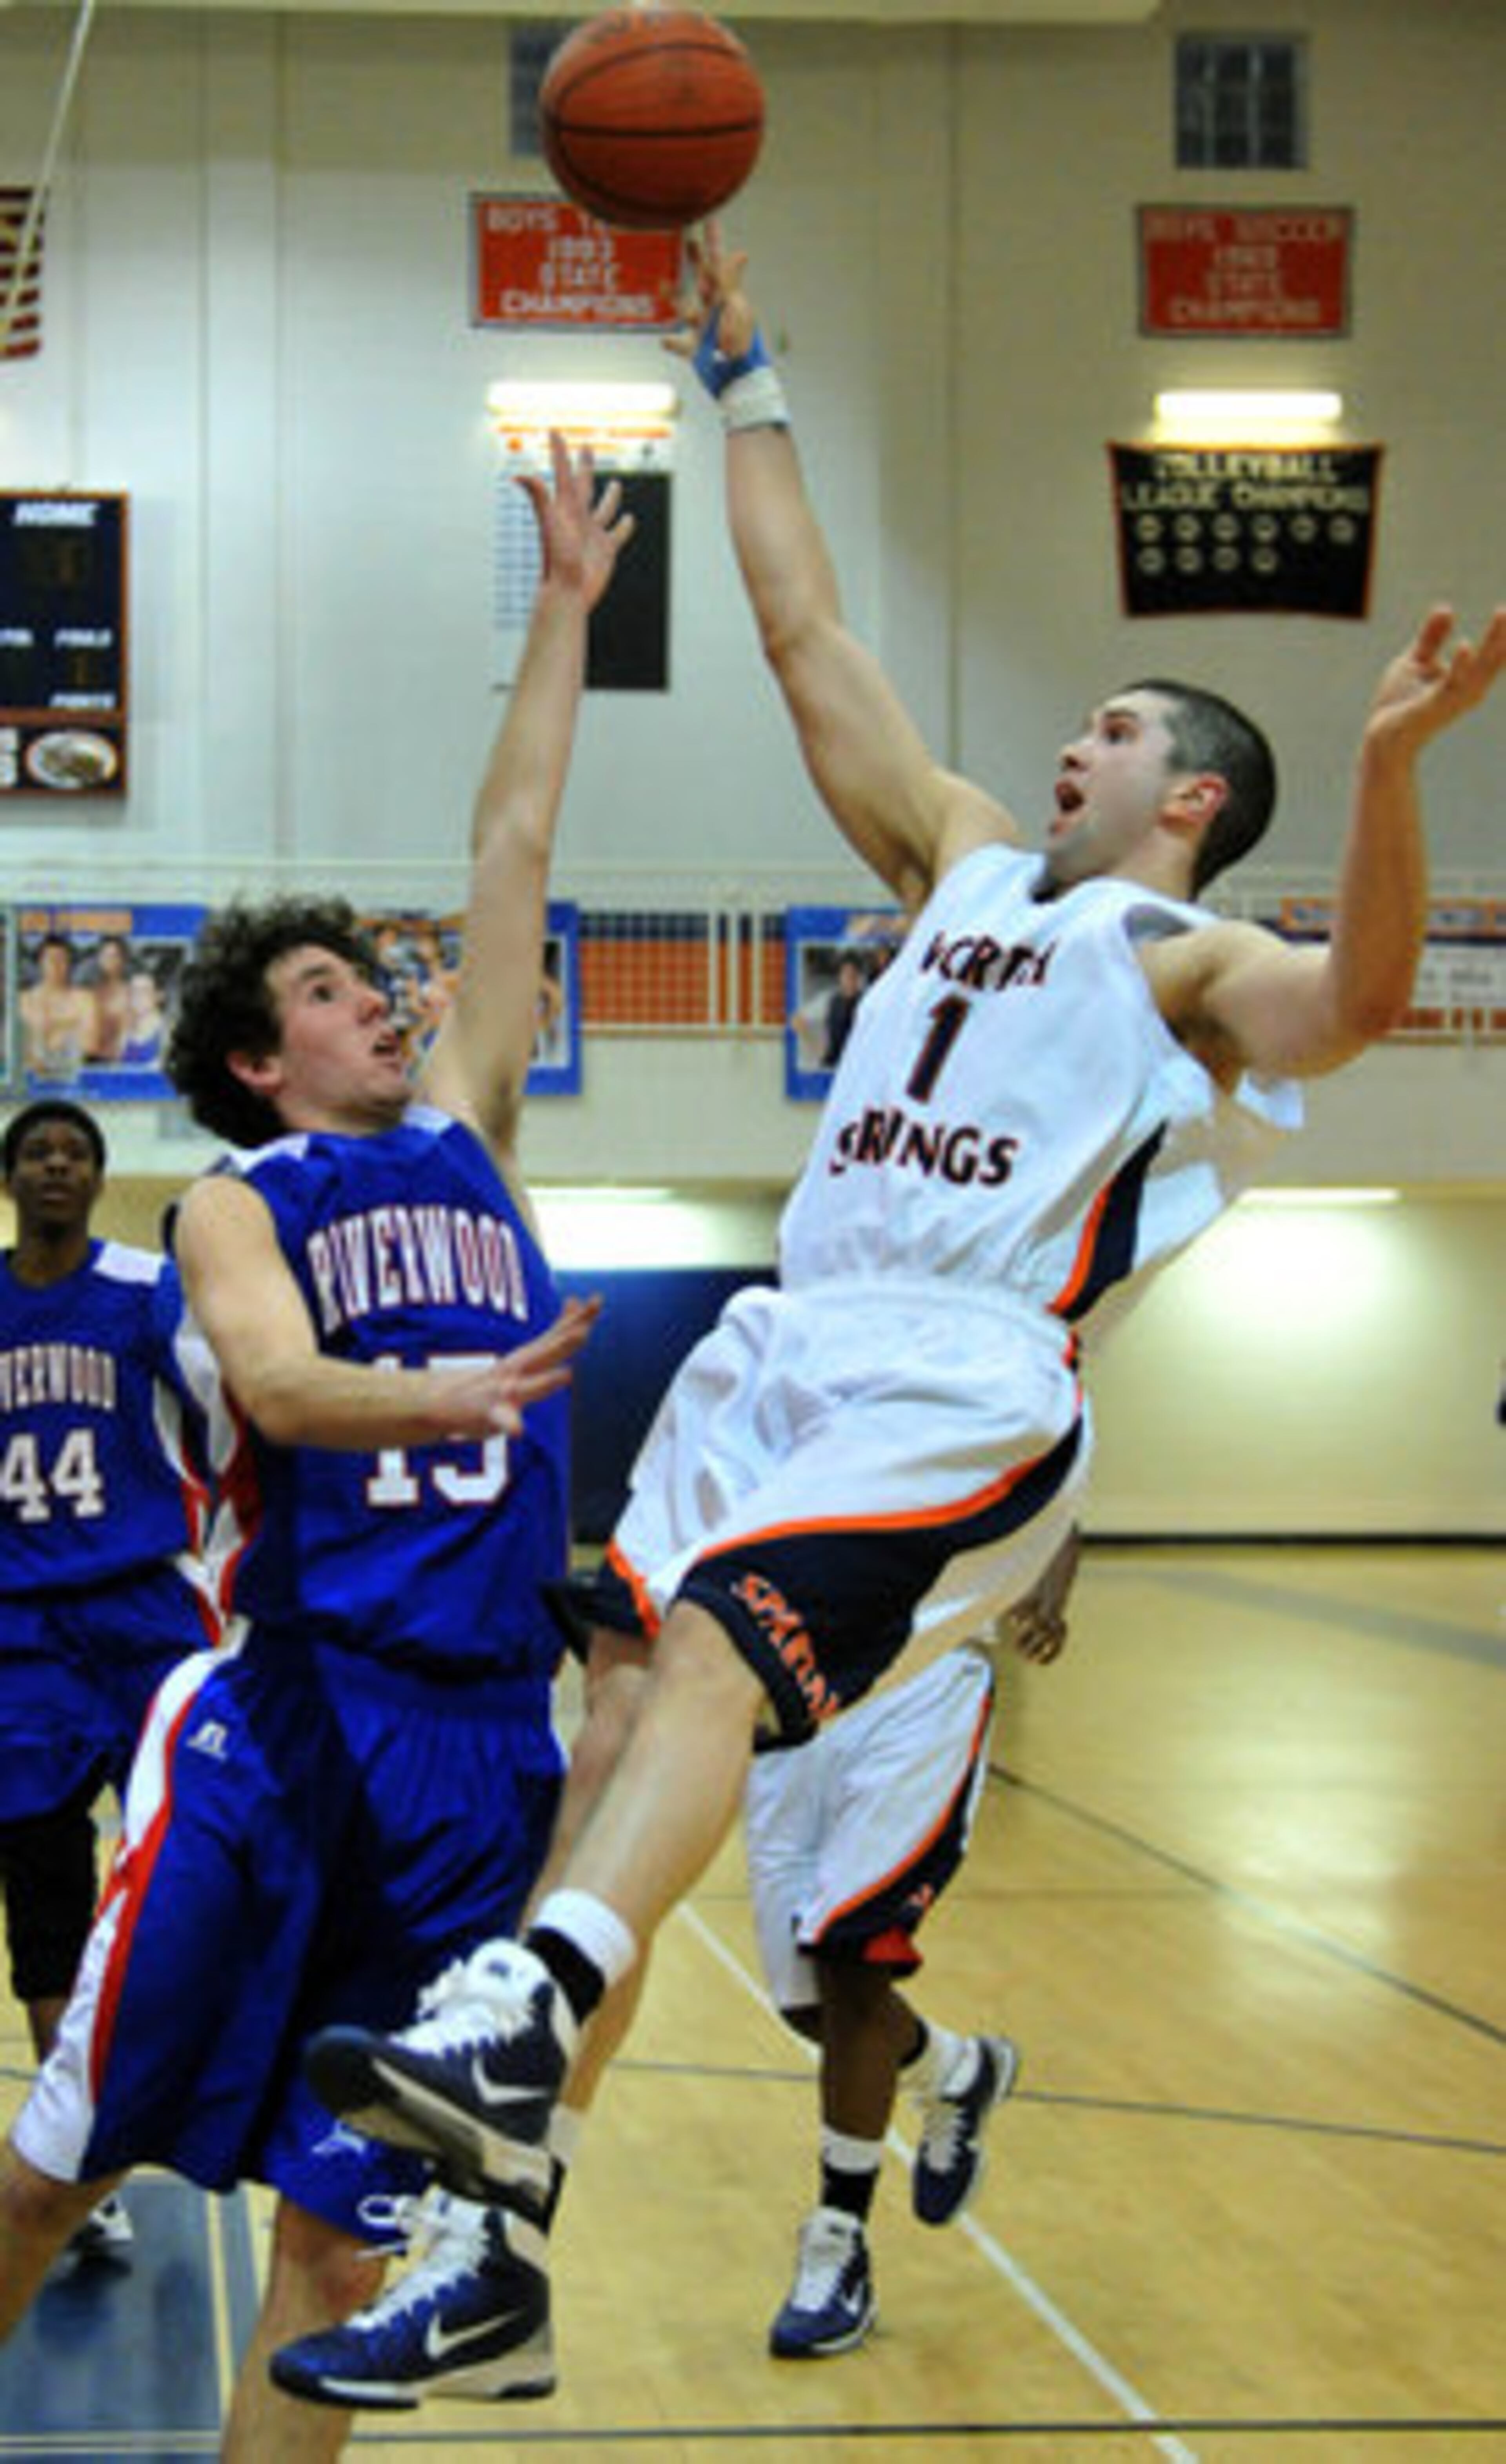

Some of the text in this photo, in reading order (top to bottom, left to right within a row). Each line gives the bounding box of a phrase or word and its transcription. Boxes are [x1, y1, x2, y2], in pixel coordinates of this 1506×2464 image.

[486, 207, 557, 232] BOYS
[540, 262, 622, 289] STATE
[1206, 271, 1286, 297] STATE
[500, 290, 653, 318] CHAMPIONS
[1170, 298, 1320, 325] CHAMPIONS
[1155, 452, 1336, 482] VOLLEYBALL
[1123, 482, 1369, 511] LEAGUE CHAMPIONS
[14, 502, 97, 527] HOME
[905, 992, 970, 1105] 1
[828, 1107, 1021, 1189] SRINGS
[0, 1428, 106, 1523] 44
